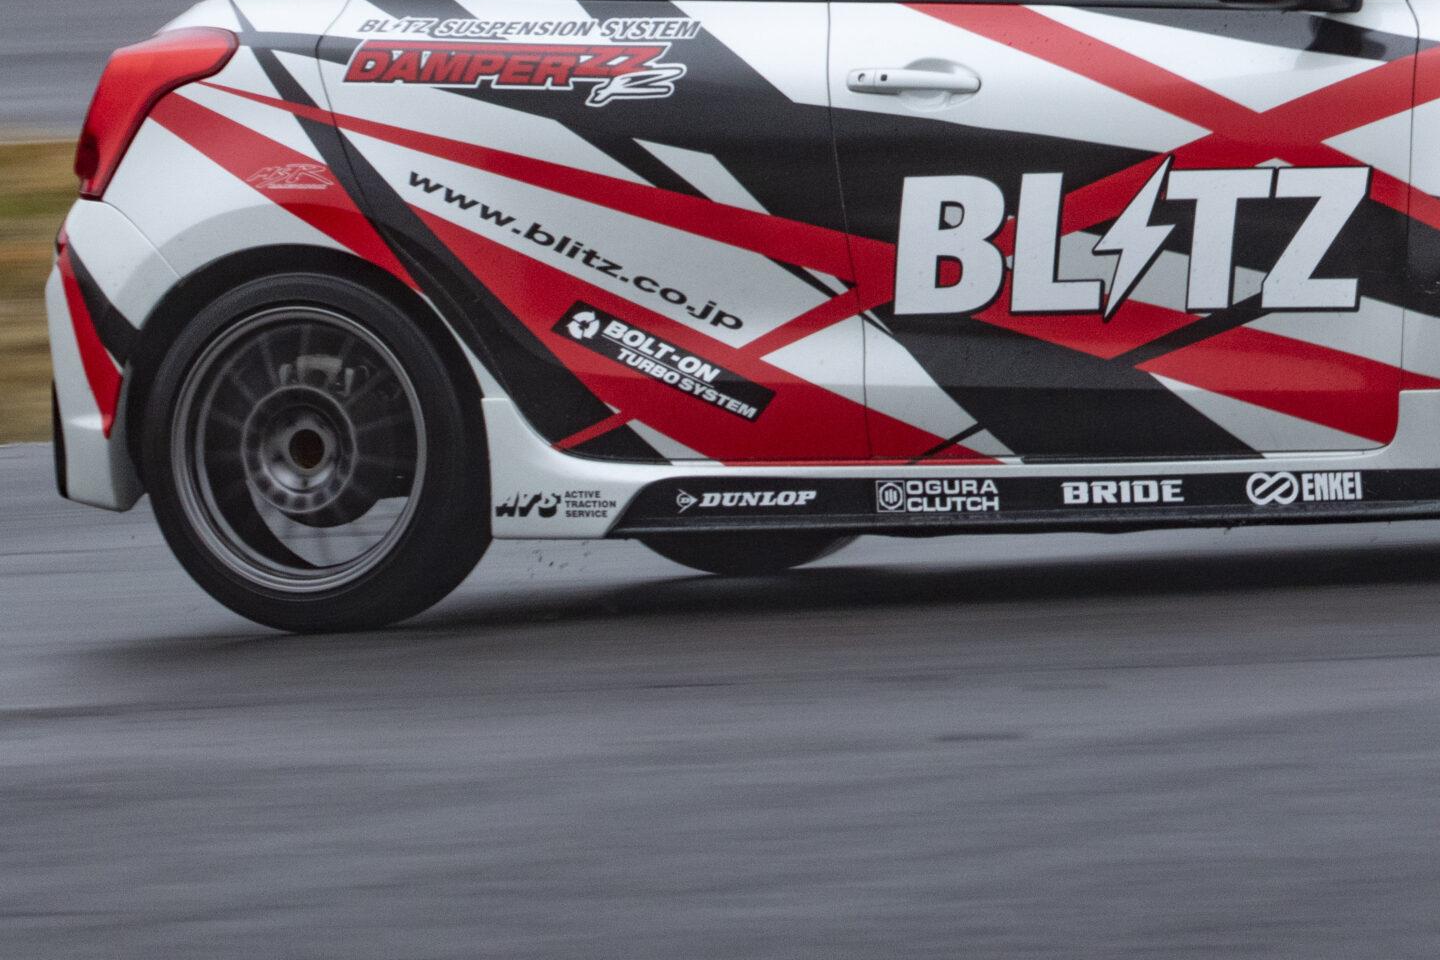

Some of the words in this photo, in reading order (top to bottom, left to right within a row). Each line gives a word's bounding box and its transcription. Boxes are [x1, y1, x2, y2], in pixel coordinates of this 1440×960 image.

[435, 16, 597, 38] SUSPENSION
[599, 17, 703, 39] SYSTEM
[893, 153, 1372, 322] BLITZ
[407, 170, 745, 332] www.blitz.co.jp
[602, 319, 721, 384] BOLT-ON
[564, 490, 601, 499] ACTIVE
[906, 479, 999, 495] OGURA
[1061, 479, 1185, 505] BRIDE
[1302, 471, 1363, 501] ENKEI
[564, 500, 617, 509] TRACTION
[698, 490, 817, 508] DUNLOP
[907, 496, 1000, 512] CLUTCH
[565, 509, 608, 518] SERVICE
